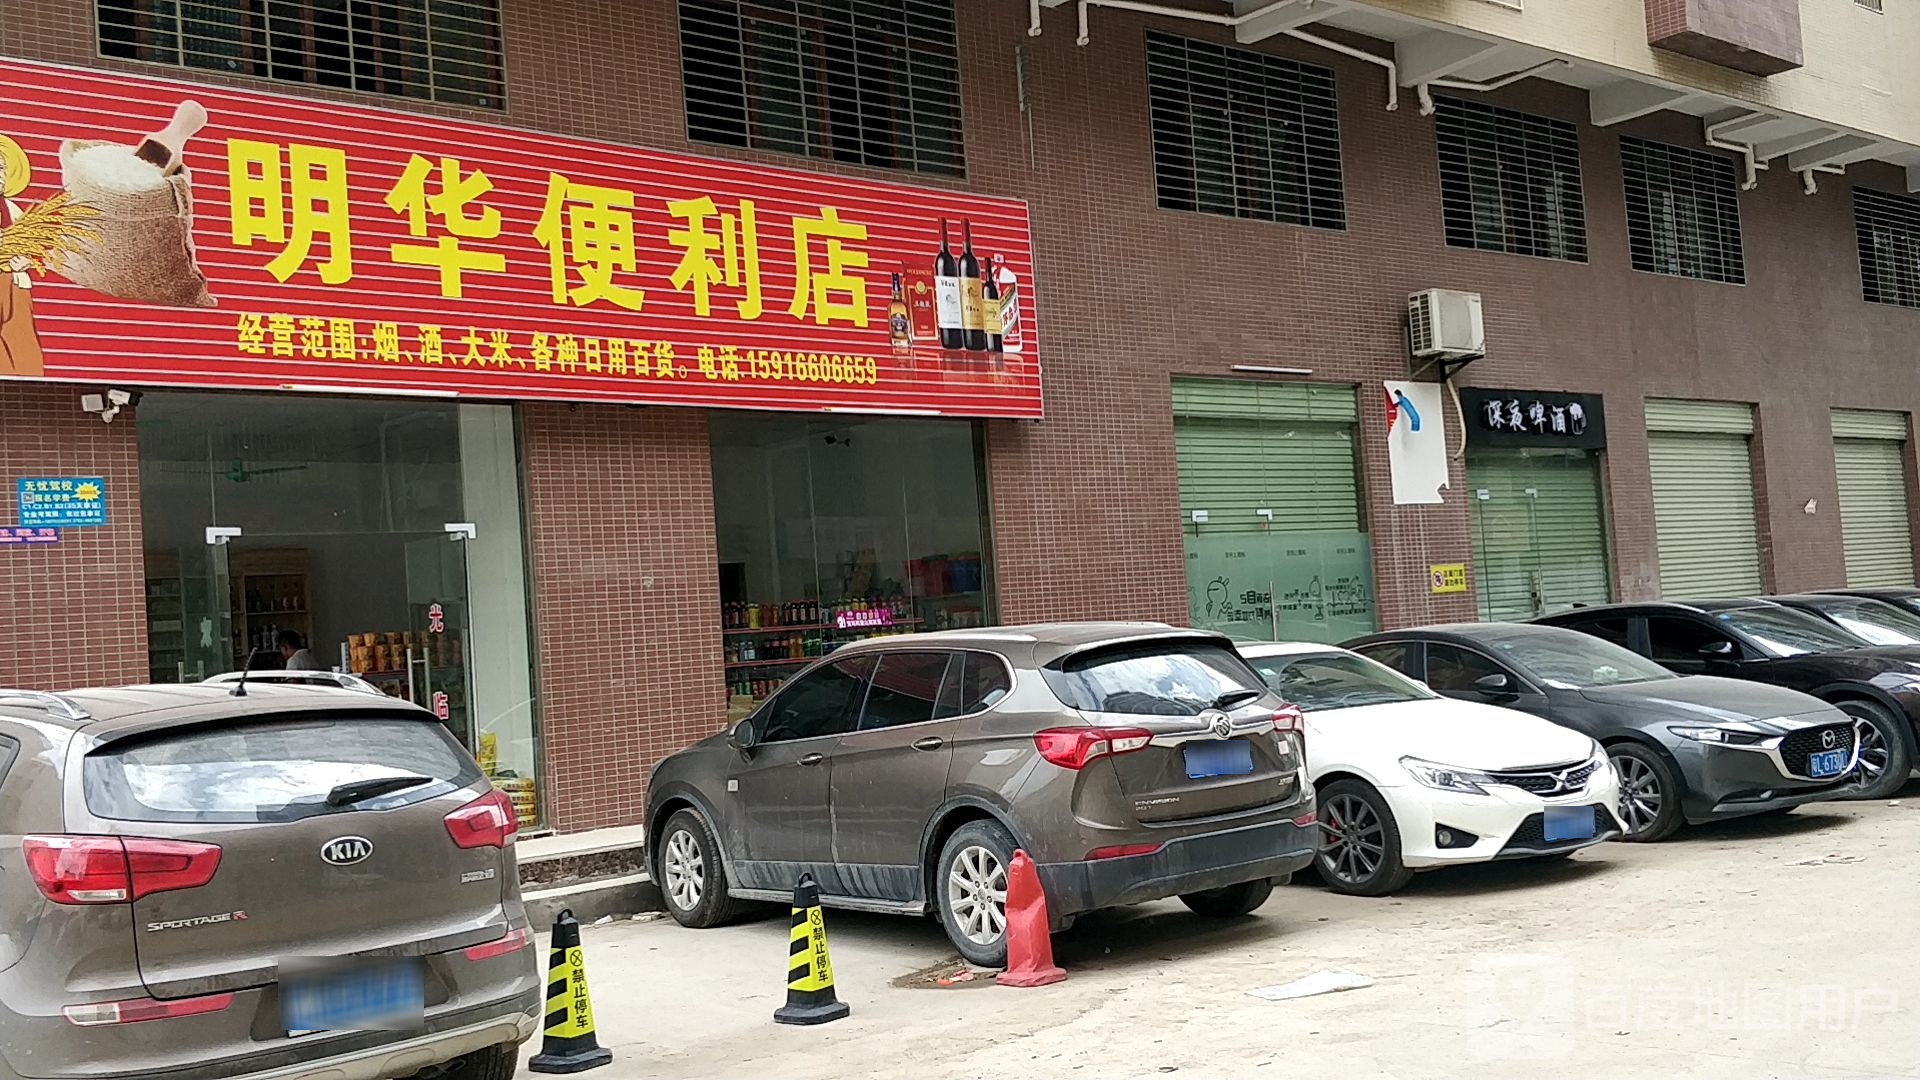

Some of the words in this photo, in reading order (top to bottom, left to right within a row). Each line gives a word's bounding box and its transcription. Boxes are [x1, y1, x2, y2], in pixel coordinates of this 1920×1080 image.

[228, 138, 870, 329] 明华便利店
[1486, 398, 1567, 434] 深夜啤酒
[428, 602, 445, 634] 光
[329, 841, 367, 862] KIA
[147, 912, 231, 933] SPORTAGE
[232, 910, 249, 921] R
[812, 926, 829, 983] 禁止停车
[571, 968, 589, 1029] 禁止停车
